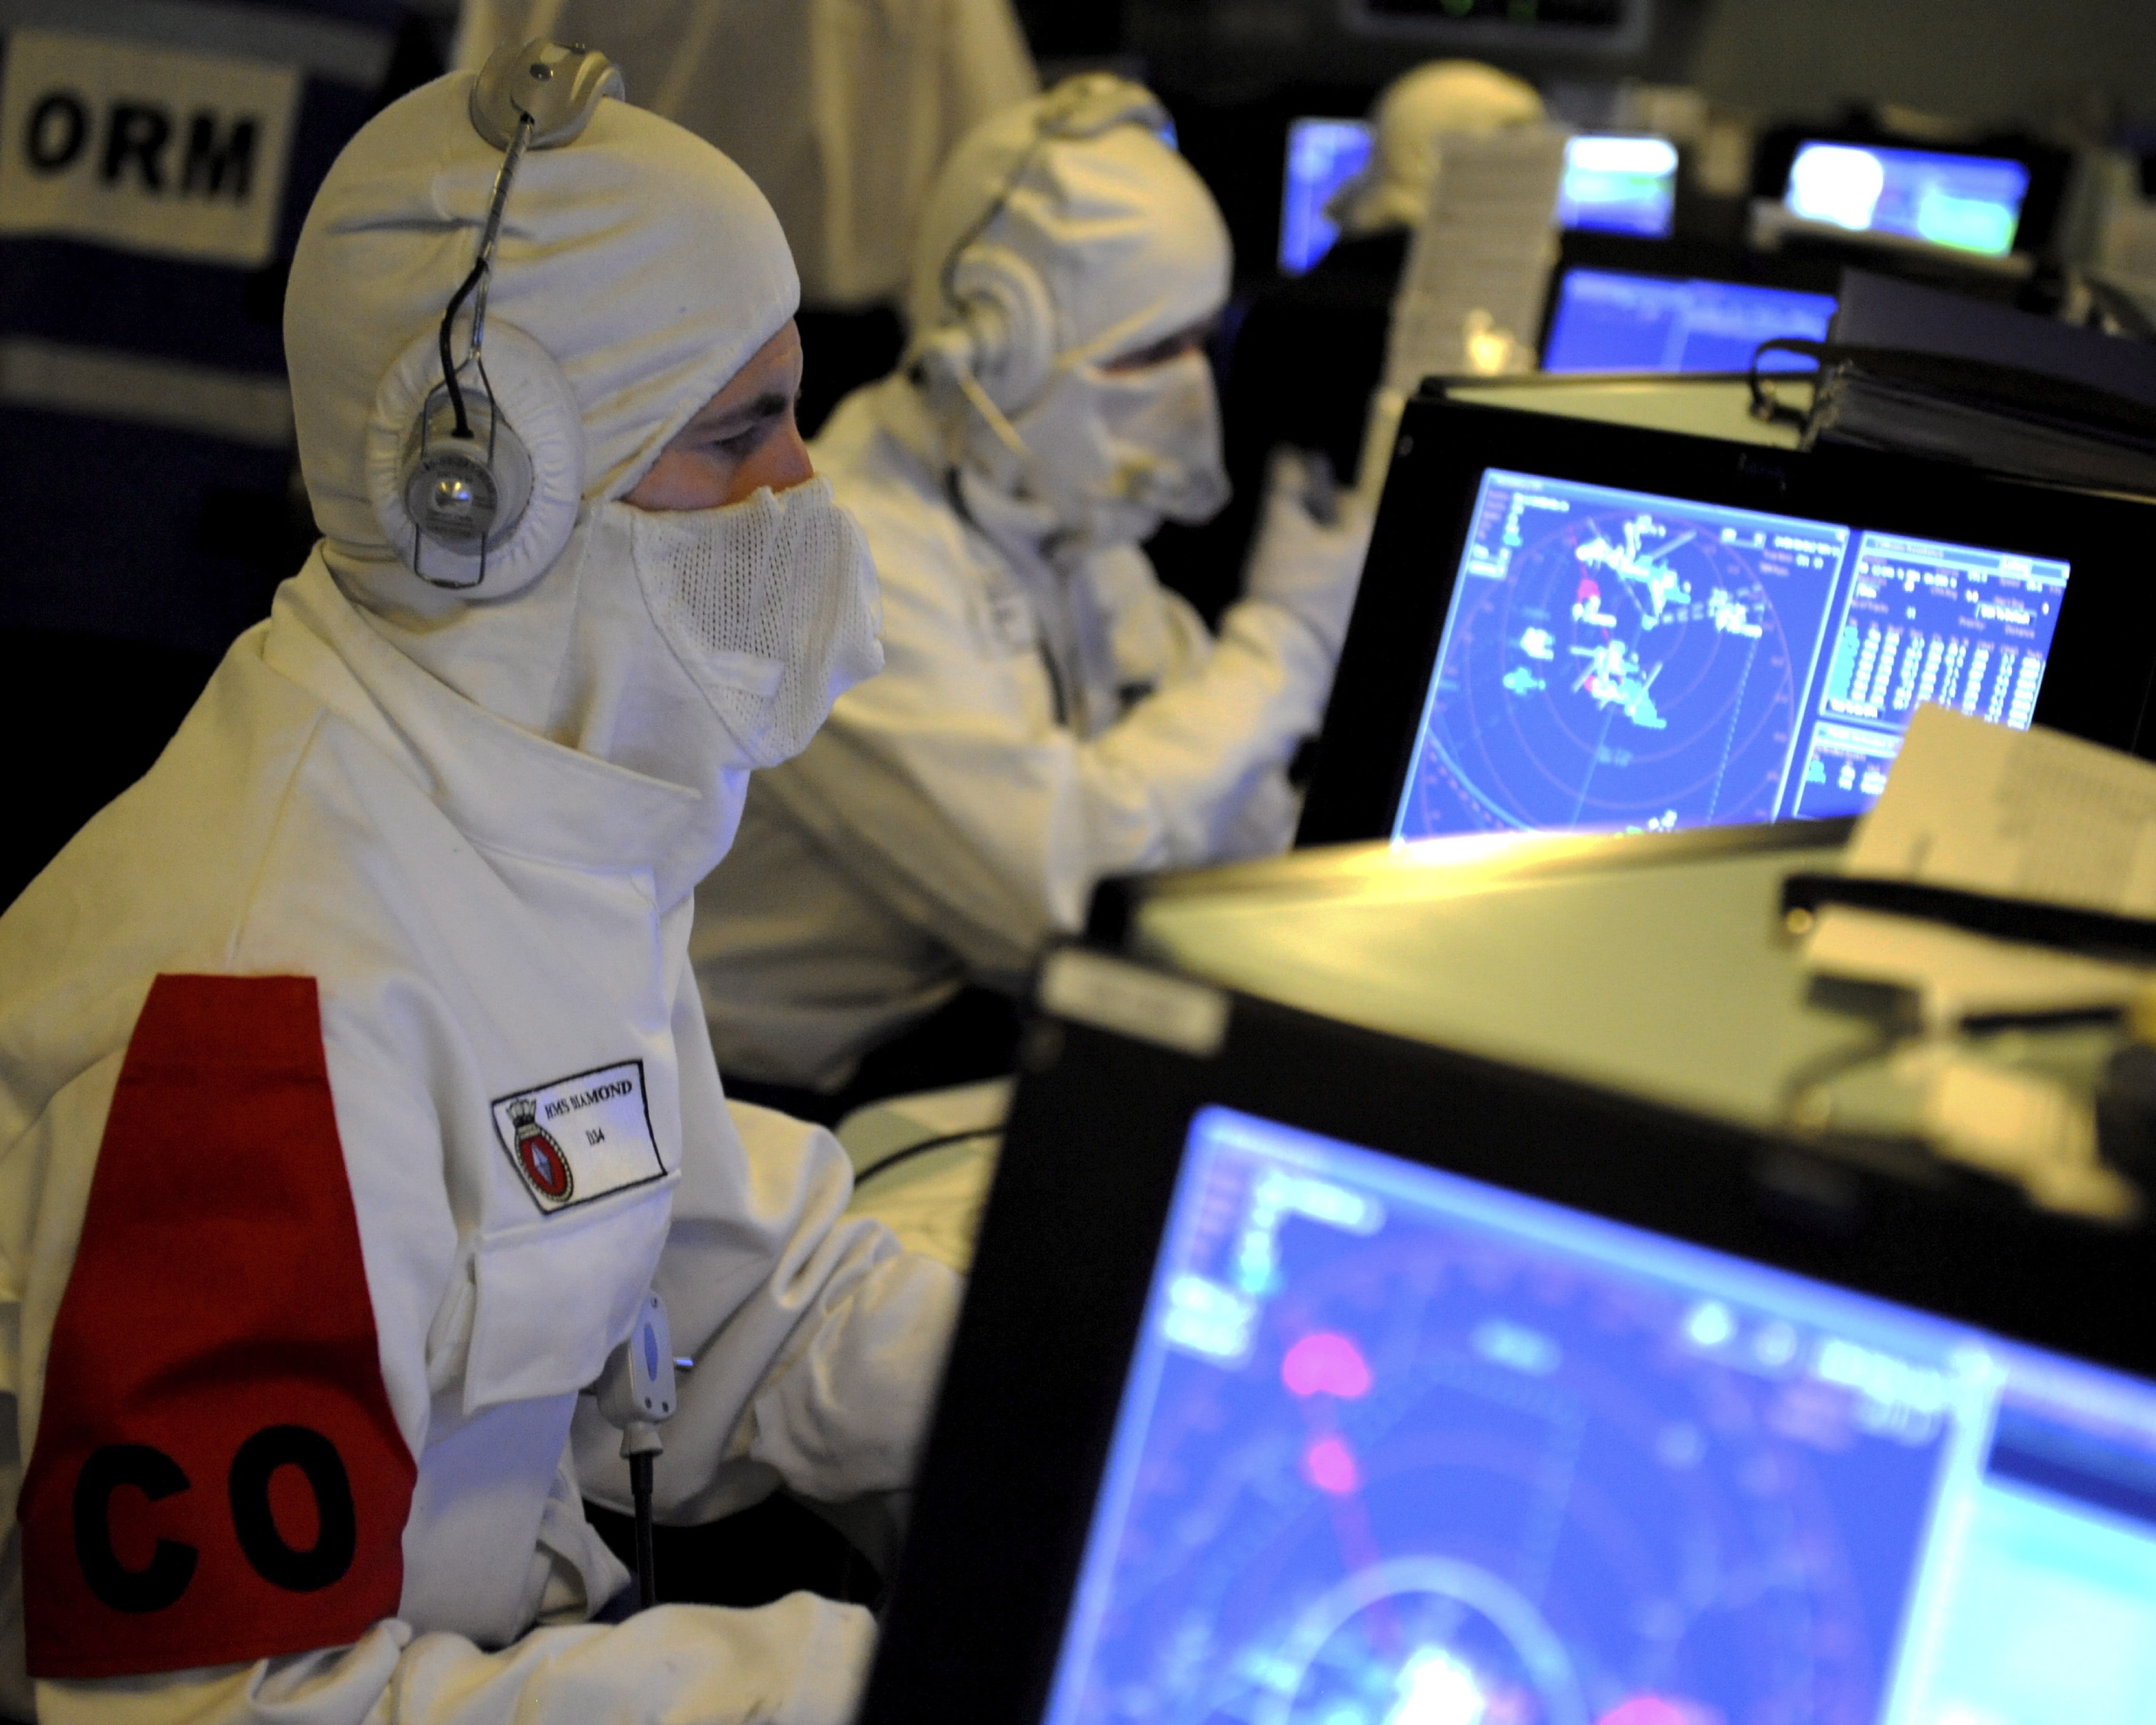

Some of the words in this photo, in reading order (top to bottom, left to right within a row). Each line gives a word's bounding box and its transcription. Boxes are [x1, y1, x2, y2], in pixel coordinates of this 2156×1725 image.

[26, 91, 260, 205] ORM
[544, 1097, 570, 1120] HMS
[569, 1080, 633, 1110] DIAMOND
[73, 1424, 357, 1613] CO
